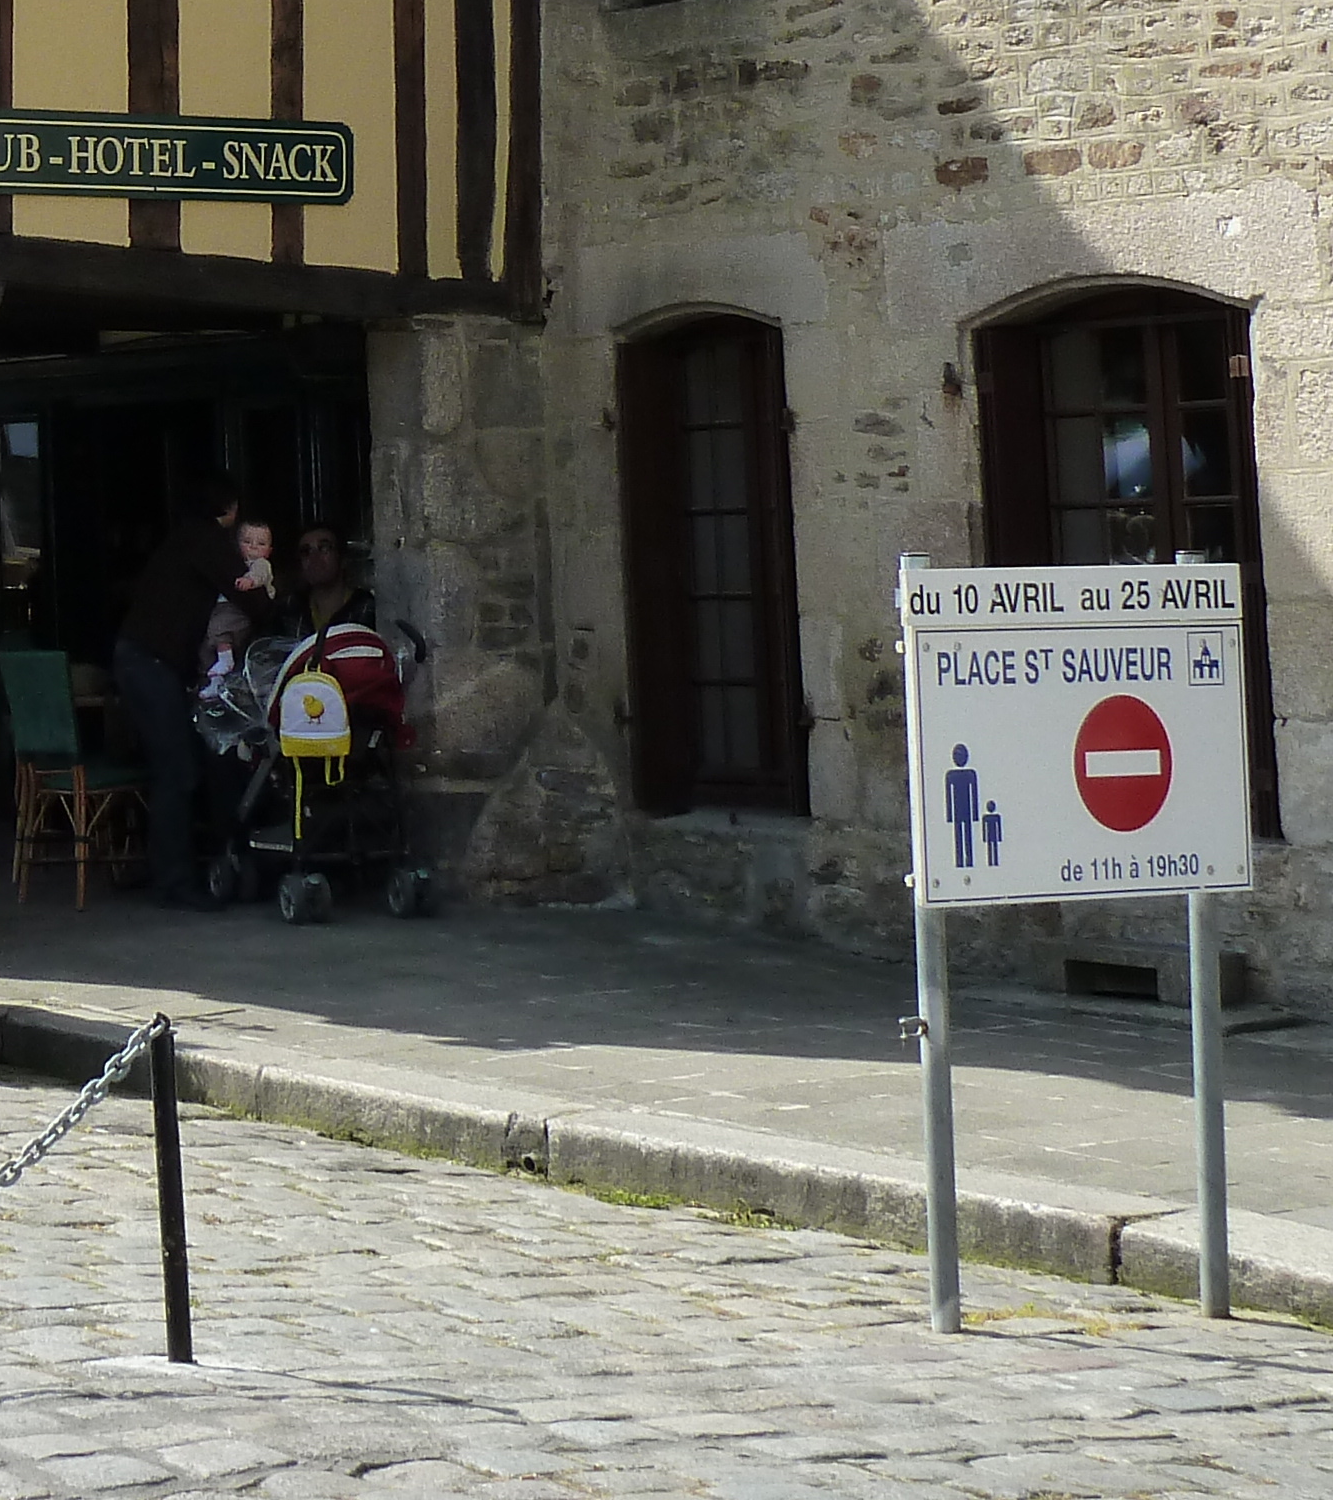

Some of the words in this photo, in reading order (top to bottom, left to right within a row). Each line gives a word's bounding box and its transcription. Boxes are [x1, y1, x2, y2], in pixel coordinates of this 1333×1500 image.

[68, 136, 196, 177] HOTEL
[223, 140, 337, 182] SNACK
[910, 584, 940, 615] du
[953, 584, 978, 614] 10
[990, 582, 1064, 613] AVRIL
[1081, 587, 1110, 611] au
[1121, 580, 1150, 610] 25
[1161, 579, 1235, 610] AVRIL
[937, 650, 1016, 686] PLACE
[1062, 647, 1172, 684] SAUVEUR
[1061, 859, 1083, 881] de
[1090, 857, 1122, 880] 11h
[1129, 854, 1139, 878] à
[1147, 853, 1199, 877] 19h30
